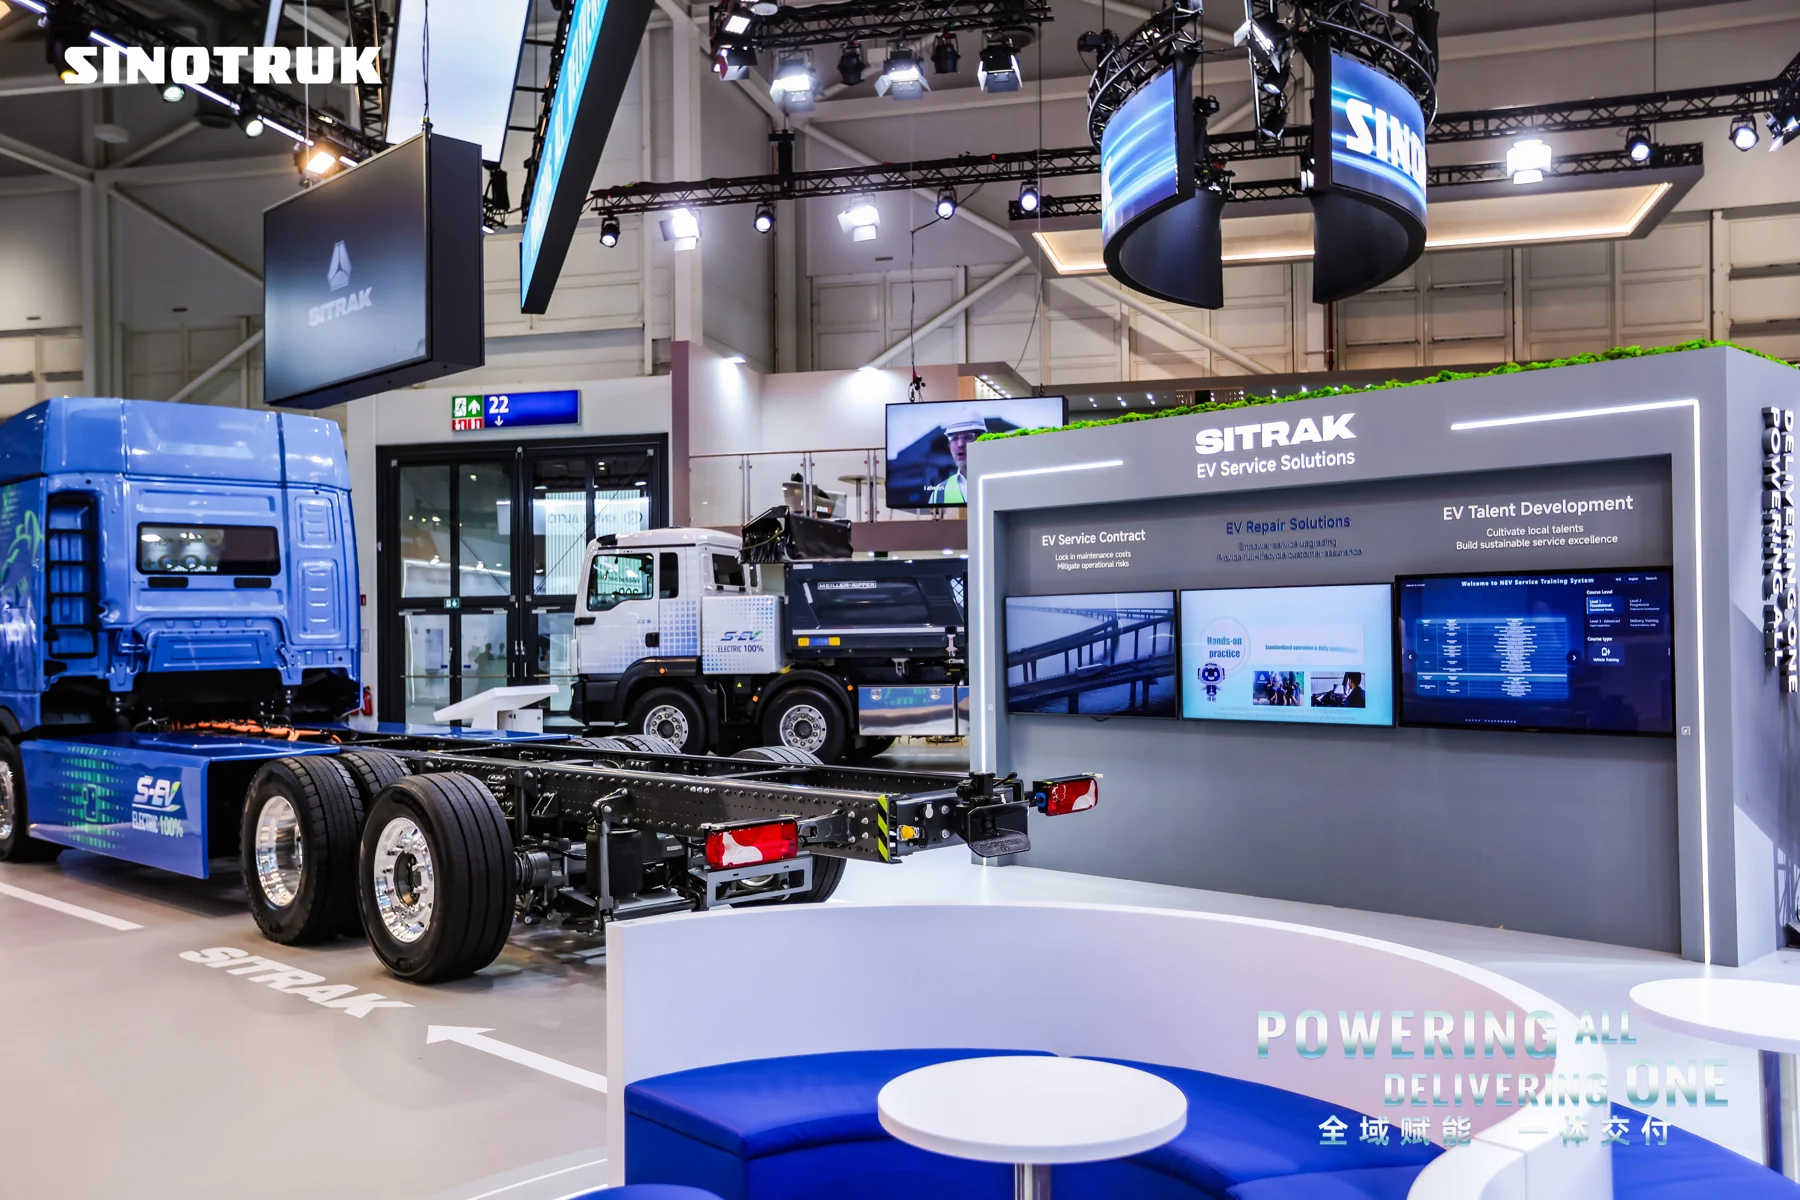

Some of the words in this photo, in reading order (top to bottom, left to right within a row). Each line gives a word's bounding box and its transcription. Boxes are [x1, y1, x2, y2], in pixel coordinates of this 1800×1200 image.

[308, 286, 373, 327] SITRAK
[488, 395, 510, 415] 22
[1194, 412, 1357, 455] SITRAK
[1196, 461, 1217, 479] EV
[1220, 457, 1277, 477] Service
[1280, 450, 1356, 471] Solutions
[1443, 506, 1464, 521] EV
[1467, 502, 1516, 519] Talent
[1520, 495, 1634, 517] Development
[1769, 406, 1784, 597] POWERING
[1782, 409, 1797, 610] DELIVERING
[1226, 521, 1243, 535] EV
[1246, 518, 1286, 536] Repair
[1289, 514, 1351, 531] Solutions
[1486, 527, 1526, 538] Cultivate
[1528, 525, 1550, 535] local
[1552, 524, 1584, 534] talents
[1042, 534, 1056, 547] EV
[1058, 532, 1097, 546] Service
[1099, 529, 1146, 543] Contract
[1456, 541, 1478, 551] Build
[1480, 538, 1530, 550] sustainable
[1532, 536, 1566, 547] service
[1568, 534, 1619, 546] excellence
[1055, 553, 1069, 561] Lock
[1070, 552, 1076, 560] in
[1076, 551, 1114, 560] maintenance
[1115, 550, 1132, 558] costs
[1057, 561, 1081, 572] Mitigate
[1081, 560, 1115, 570] operational
[1115, 560, 1130, 568] risks
[818, 581, 876, 589] MEILLER-KIPPER
[1540, 578, 1568, 586] Training
[1570, 577, 1594, 585] System
[1207, 636, 1242, 646] Hands-on
[1772, 604, 1784, 667] ALL
[717, 645, 742, 653] ELECTRIC
[743, 644, 764, 653] 100%
[1209, 648, 1240, 659] practice
[1785, 620, 1799, 694] ONE
[132, 811, 159, 834] ELECTRIC
[160, 815, 184, 838] 100%
[178, 946, 417, 1019] SITRAK
